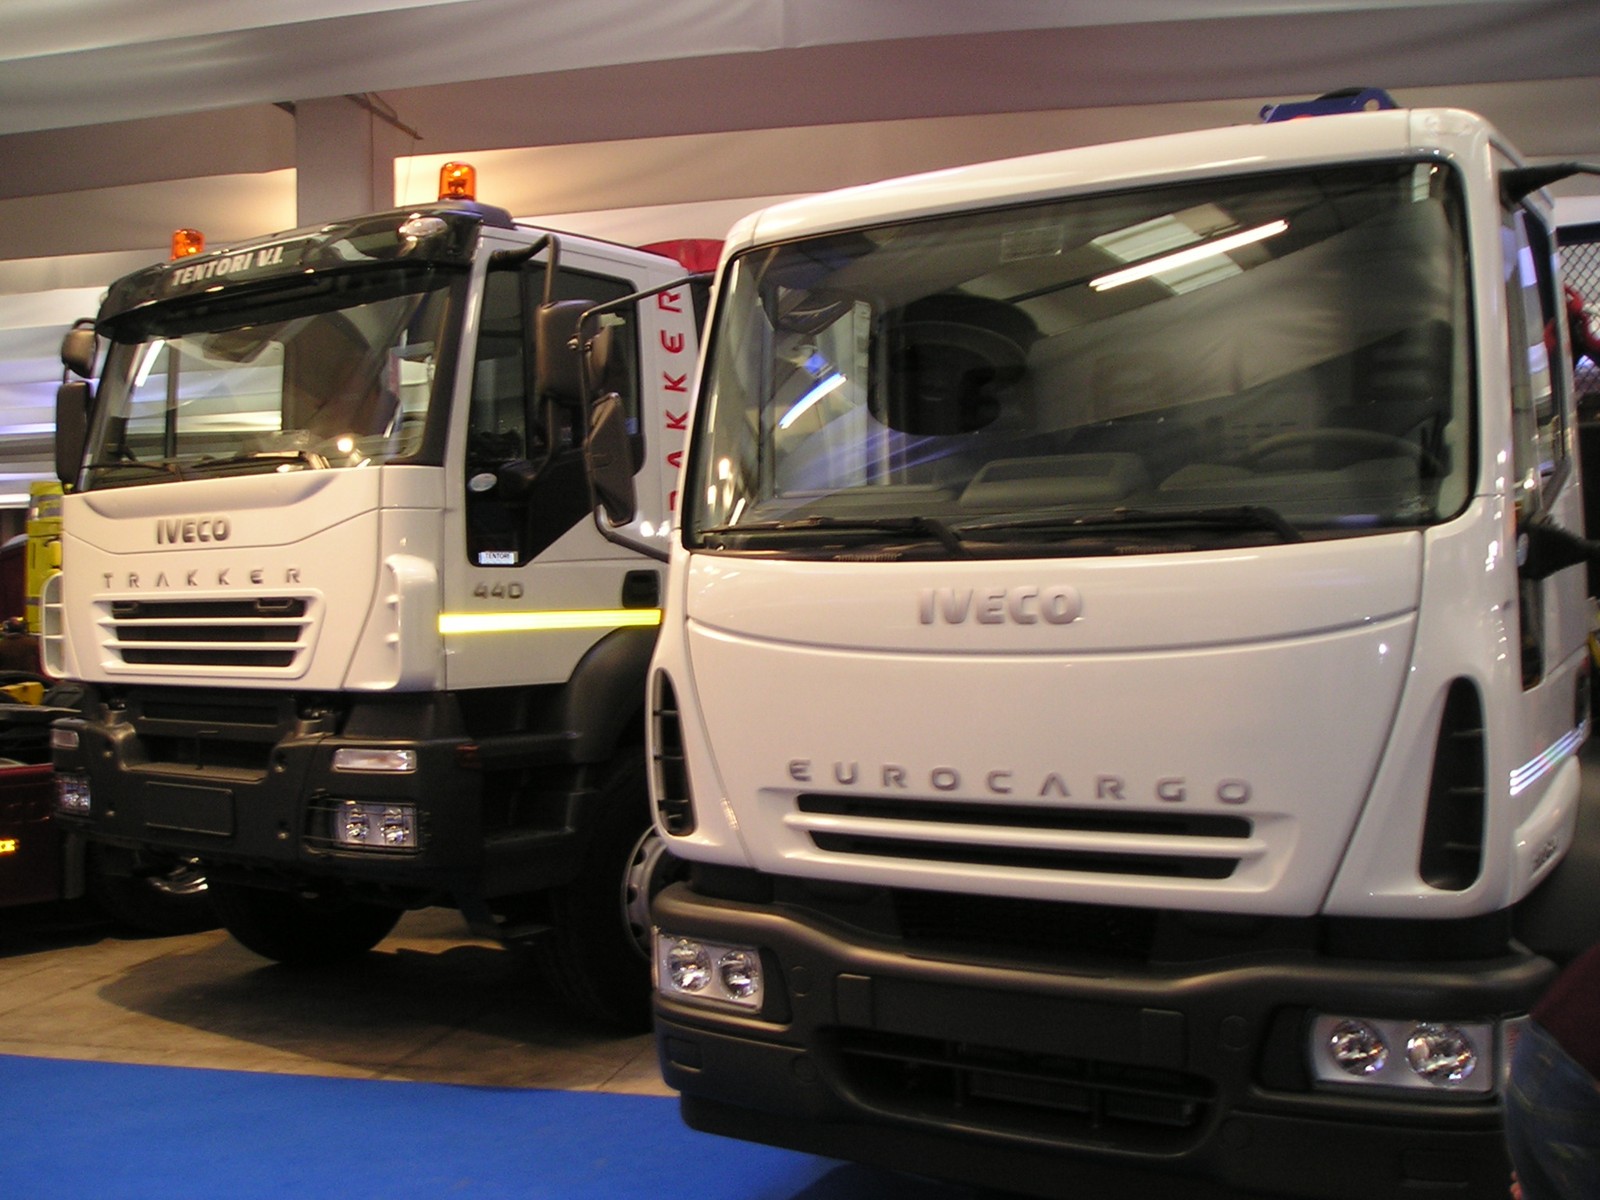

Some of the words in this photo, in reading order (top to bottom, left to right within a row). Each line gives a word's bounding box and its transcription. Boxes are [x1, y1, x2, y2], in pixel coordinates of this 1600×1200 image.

[171, 253, 253, 286] TENTORI
[156, 519, 230, 545] IVECO
[103, 567, 301, 589] TRAKKER
[474, 582, 524, 599] 440
[919, 585, 1082, 625] IVECO
[788, 758, 1252, 804] EUROCARGO
